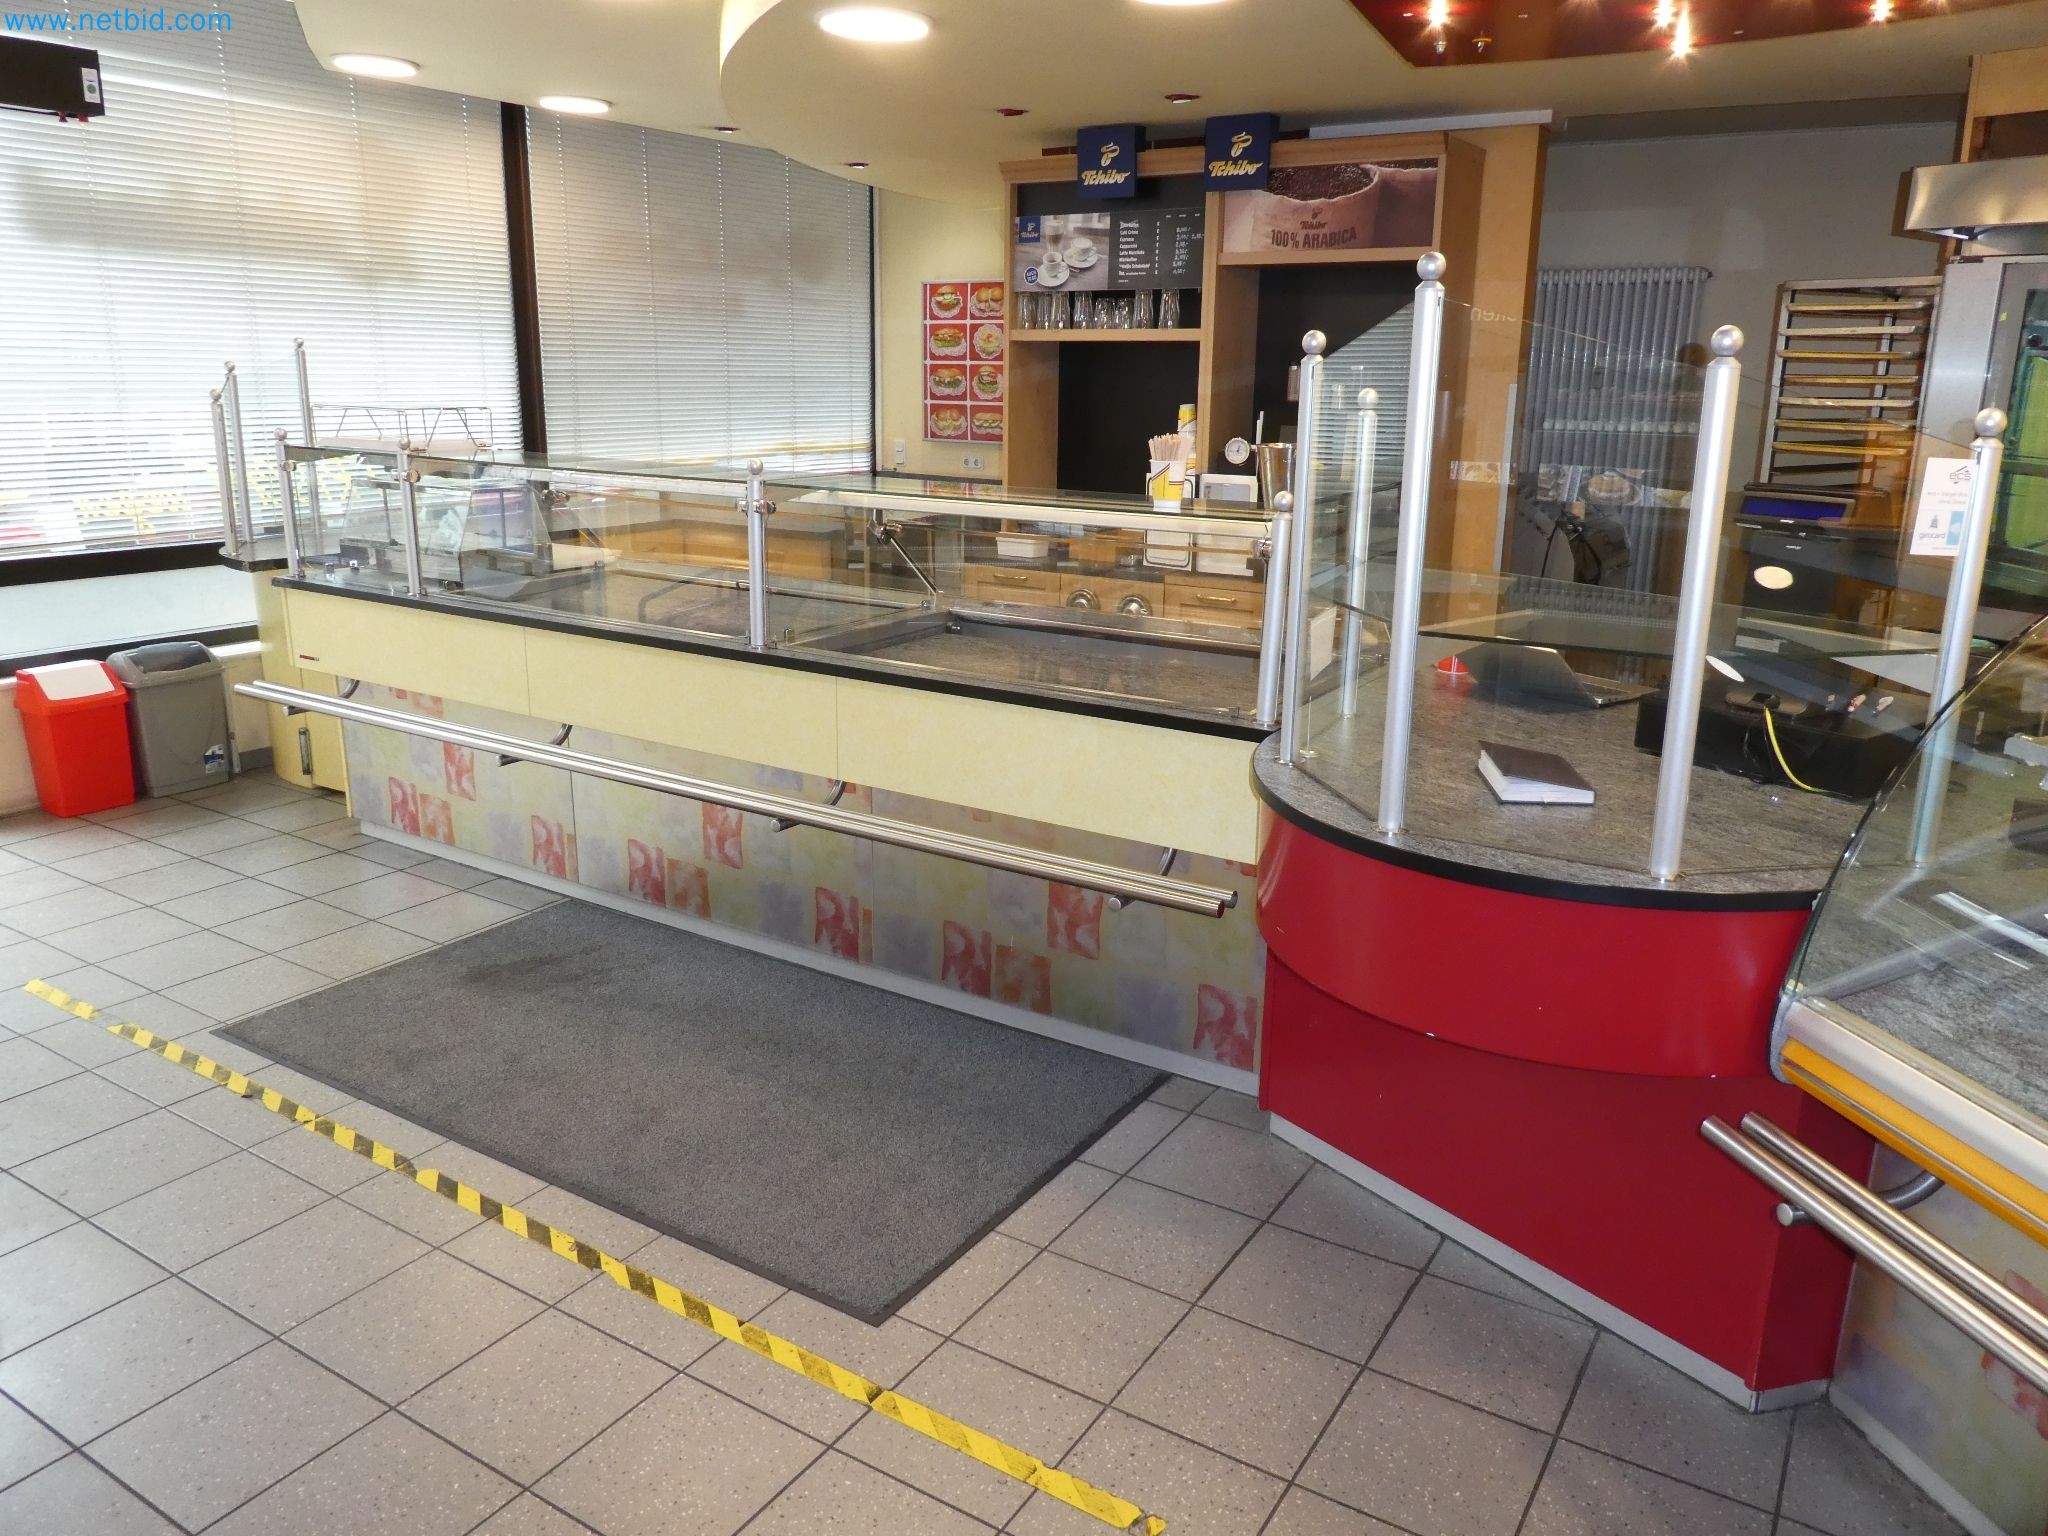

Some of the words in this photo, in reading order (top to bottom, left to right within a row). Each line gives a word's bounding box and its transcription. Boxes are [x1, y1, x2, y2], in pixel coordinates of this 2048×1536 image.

[1208, 160, 1264, 177] Tchibo
[1082, 170, 1131, 185] Tchibo
[1271, 229, 1299, 248] 100%
[1302, 227, 1357, 248] ARABICA
